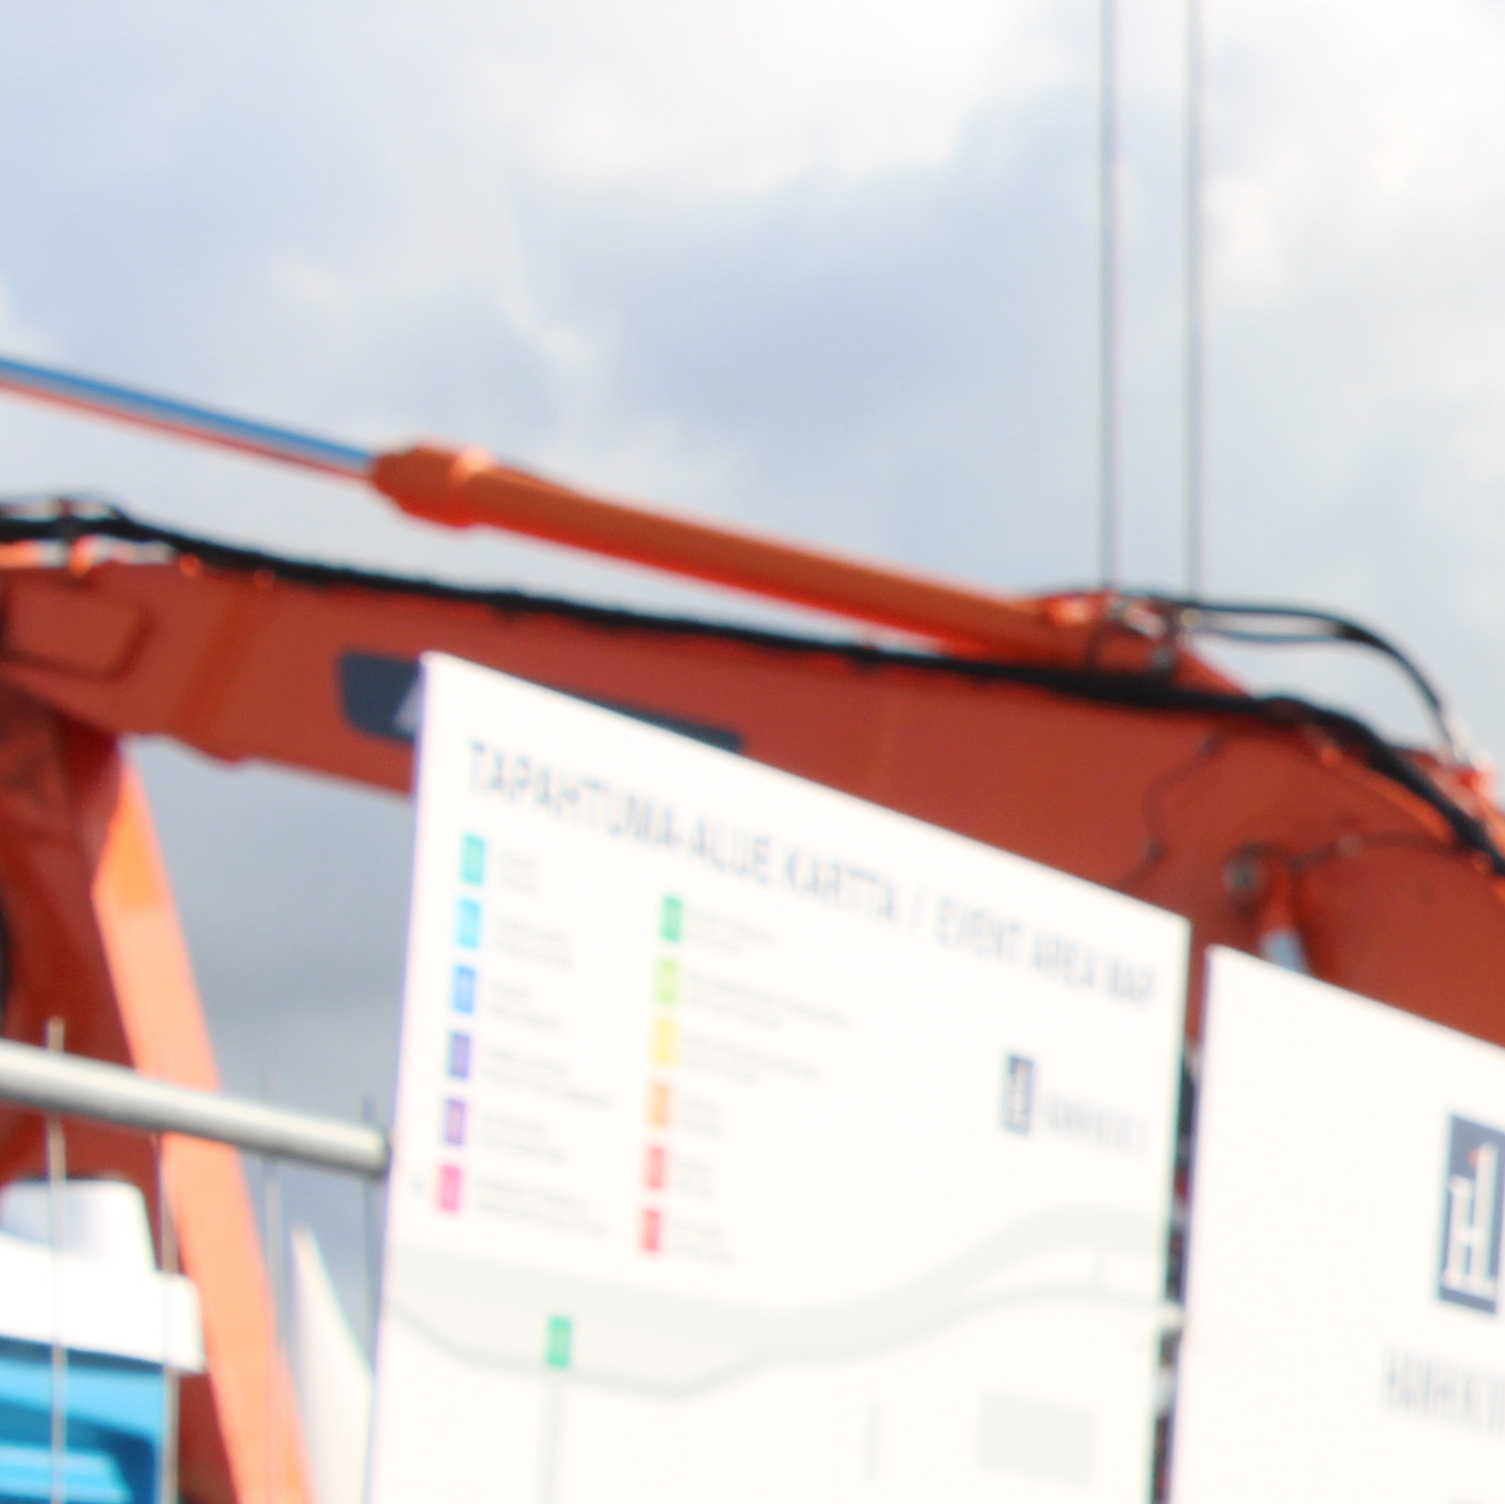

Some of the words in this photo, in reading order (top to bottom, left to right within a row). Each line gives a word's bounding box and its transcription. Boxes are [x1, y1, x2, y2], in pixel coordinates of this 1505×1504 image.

[467, 738, 772, 887] TAPAHTUMA-ALUE
[782, 845, 900, 927] KARTTA
[934, 893, 1027, 965] EVENT
